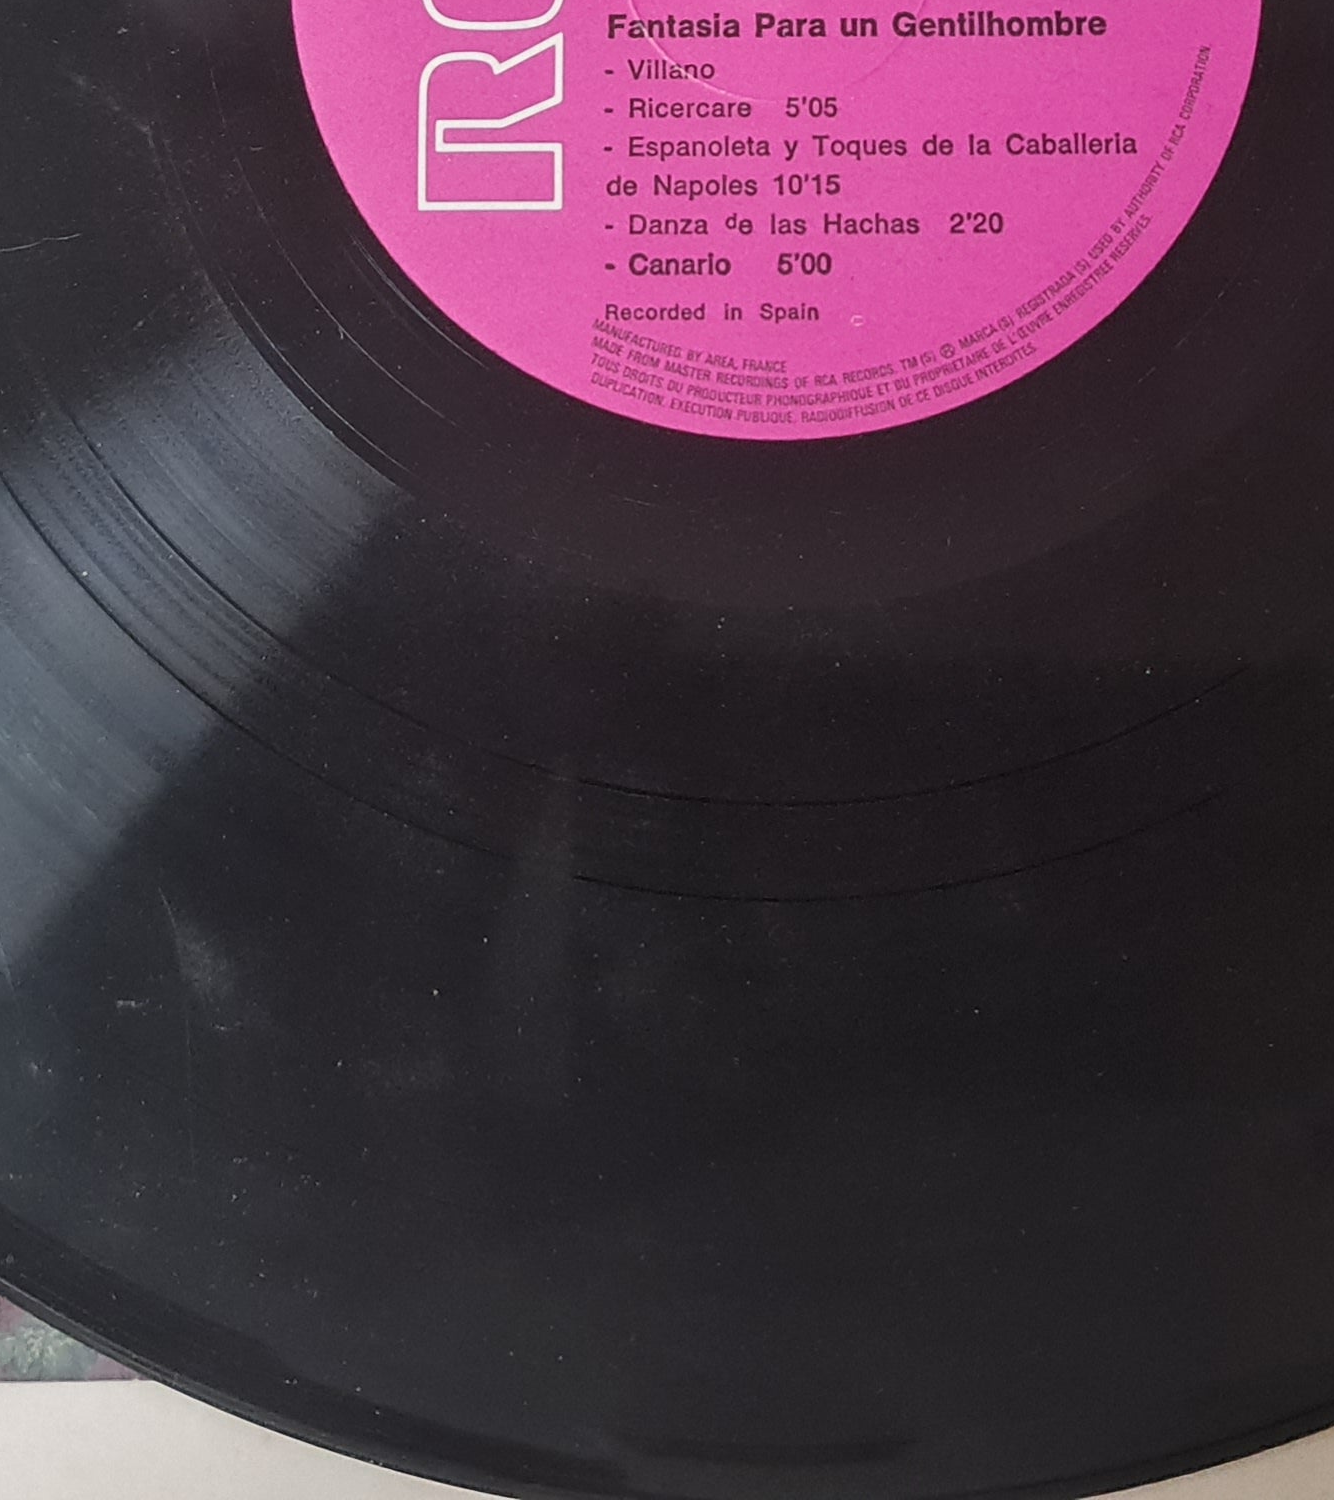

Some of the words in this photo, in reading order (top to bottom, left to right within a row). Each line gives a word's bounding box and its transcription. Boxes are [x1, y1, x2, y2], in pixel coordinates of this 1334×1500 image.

[607, 12, 740, 39] Fantasia
[755, 12, 827, 38] Para
[840, 17, 878, 37] un
[892, 9, 1107, 38] Gentilhombre
[628, 58, 715, 80] Villano
[629, 97, 752, 119] Ricercare
[785, 95, 838, 118] 5'05
[628, 135, 771, 162] Espanoleta
[783, 139, 799, 162] y
[811, 134, 908, 161] Toques
[922, 133, 954, 156] de
[968, 133, 992, 156] la
[1005, 131, 1138, 156] Caballeria
[606, 174, 638, 197] de
[653, 173, 758, 202] Napoles
[773, 173, 841, 196] 10'15
[629, 214, 709, 236] Danza
[724, 212, 754, 236] de
[770, 212, 807, 236] las
[823, 212, 920, 235] Hachas
[949, 211, 1004, 234] 2'20
[591, 335, 624, 357] MADE
[626, 349, 661, 368] FROM
[664, 360, 712, 381] MASTER
[716, 371, 789, 389] RECORDINGS
[793, 376, 809, 389] OF
[814, 373, 838, 387] RCA
[1015, 270, 1076, 319] REGISTRADA
[1087, 233, 1113, 260] USED
[1110, 218, 1127, 234] BY
[1124, 160, 1165, 219] AUTHORITY
[1160, 145, 1176, 161] OF
[1169, 123, 1186, 147] RCA
[628, 252, 732, 276] Canario
[777, 251, 833, 276] 5'00
[604, 302, 706, 321] Recorded
[724, 302, 743, 321] in
[759, 302, 820, 324] Spain
[591, 318, 682, 358] MANUFACTURED
[687, 348, 703, 362] BY
[742, 358, 788, 373] FRANCE
[591, 352, 622, 374] TOUS
[622, 365, 664, 389] DROITS
[667, 379, 684, 394] DU
[687, 384, 763, 406] PRODUCTEUR
[766, 385, 874, 406] PHONOGRAPHIQUE
[876, 382, 891, 396] ET
[894, 376, 911, 391] DU
[991, 338, 1007, 355] DE
[670, 397, 733, 420] EXECUTION
[801, 399, 896, 423] RADIODIFFUSION
[898, 393, 914, 408] DE
[915, 388, 931, 403] CE
[932, 372, 975, 398] DISQUE
